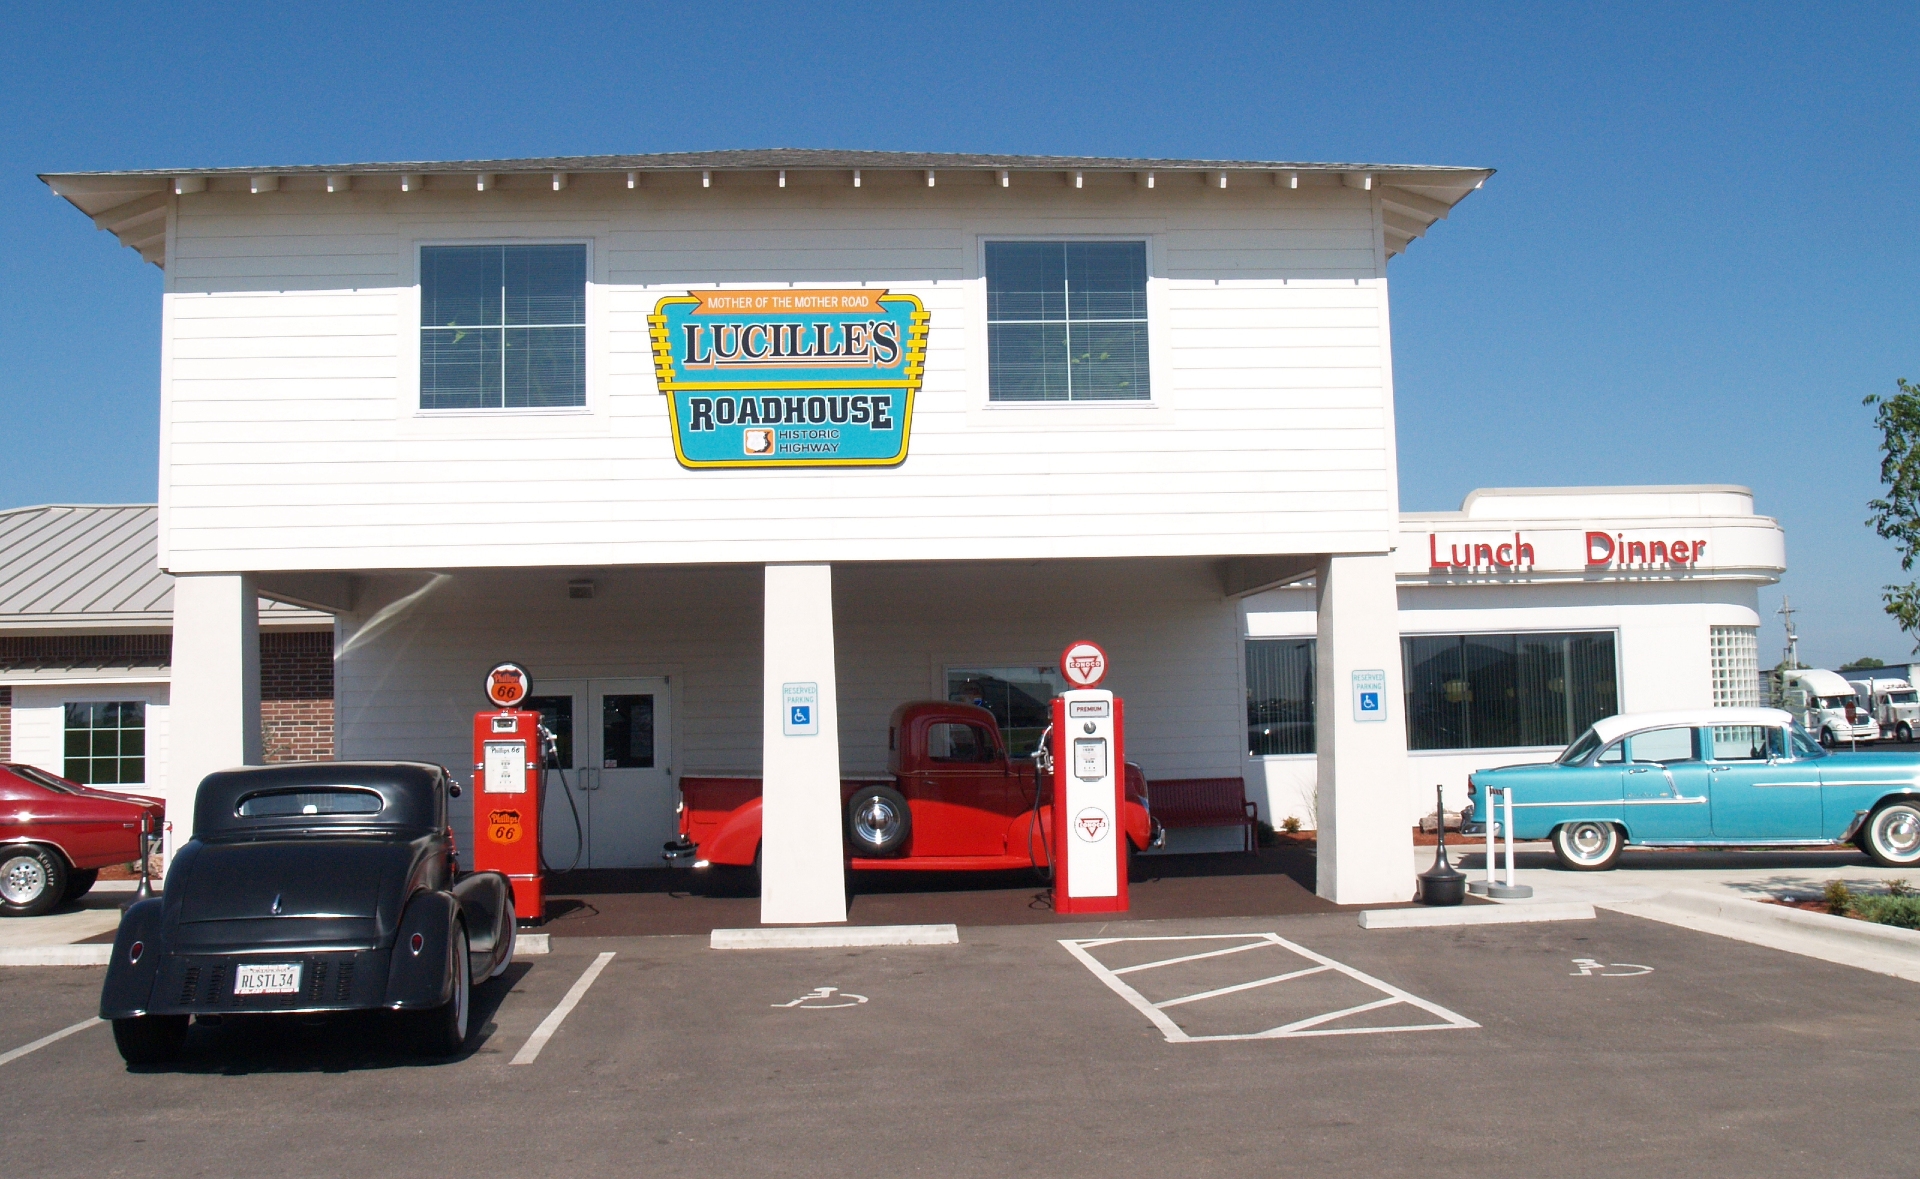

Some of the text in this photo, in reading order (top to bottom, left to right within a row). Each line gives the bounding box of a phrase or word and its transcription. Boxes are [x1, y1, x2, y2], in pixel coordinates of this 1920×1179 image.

[708, 296, 869, 308] MOTHER OF THE MOTHER ROAD
[682, 320, 899, 366] LUCILLE'S
[690, 395, 893, 431] ROADHOUSE
[779, 429, 840, 440] HISTORIC
[779, 442, 840, 453] HIGHWAY
[1429, 531, 1707, 568] Lunch Dinner
[1070, 661, 1101, 669] CONOCO
[1353, 673, 1384, 681] RESERVED
[784, 686, 816, 695] RESERVED
[1356, 682, 1382, 690] PARKING
[497, 685, 516, 699] 66
[787, 695, 814, 704] PARKING
[496, 826, 515, 840] 66
[242, 974, 294, 988] RLSTL34
